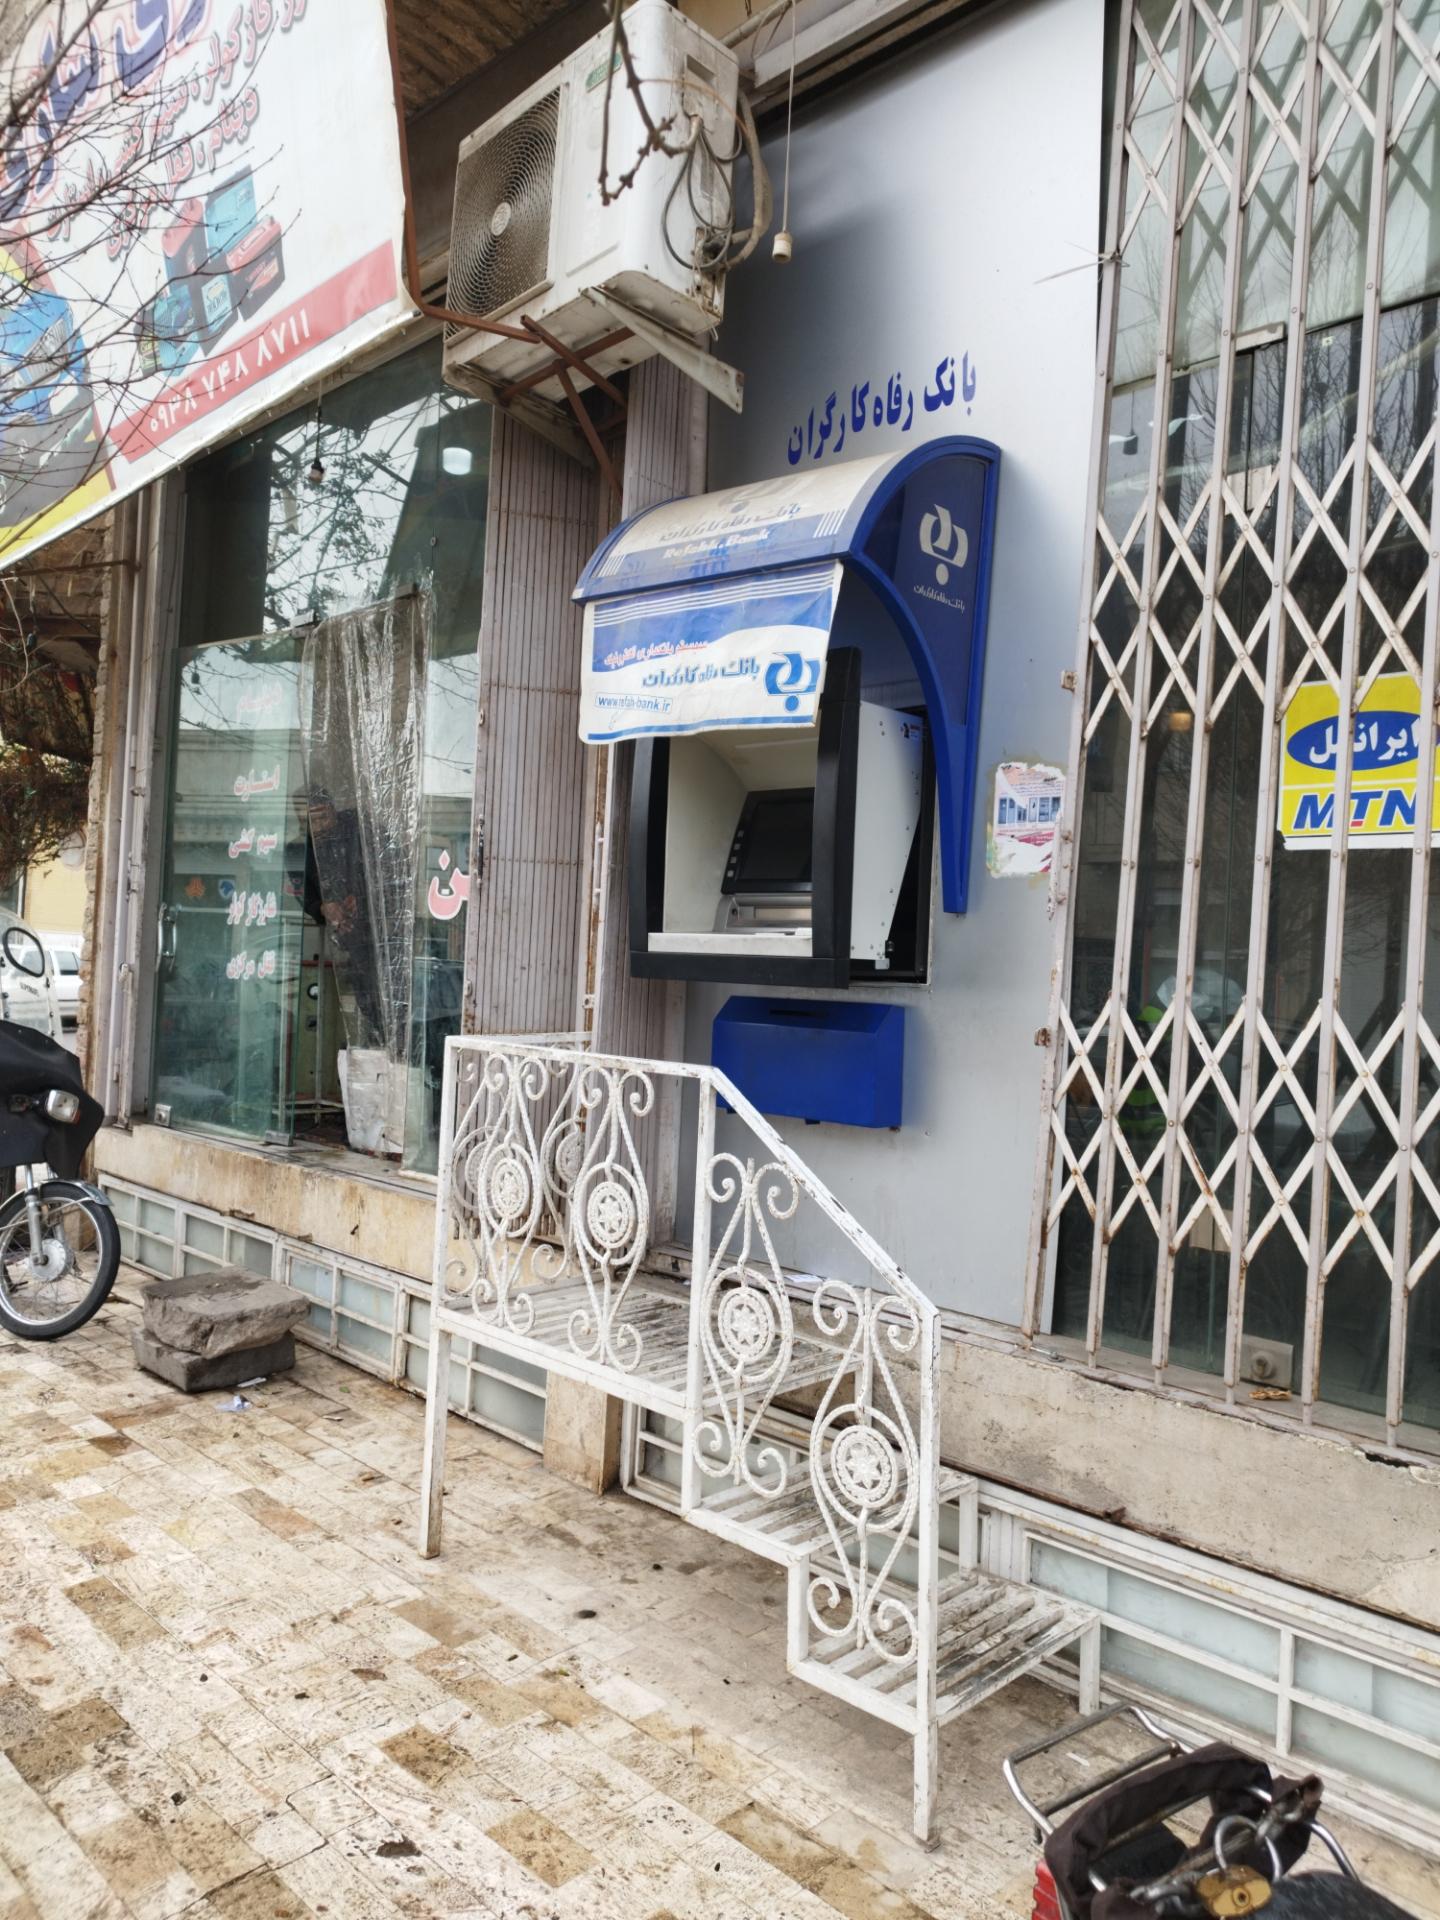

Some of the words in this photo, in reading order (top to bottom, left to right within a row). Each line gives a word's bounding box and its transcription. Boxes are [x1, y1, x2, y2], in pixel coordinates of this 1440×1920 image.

[256, 308, 310, 367] ۸۷۱۱
[924, 350, 976, 417] بانک
[872, 371, 914, 432] رفاه
[787, 380, 870, 466] کارگران
[721, 513, 752, 530] رفاه
[754, 502, 801, 523] بانک
[660, 519, 720, 542] کارگران
[676, 639, 709, 656] سیستم
[642, 664, 700, 687] کارگران
[721, 655, 761, 681] بانک
[1308, 716, 1421, 765] ایرانل
[233, 764, 281, 802] استارت
[1292, 788, 1419, 831] MTN
[228, 828, 256, 859] کشی
[256, 832, 278, 855] سیم
[226, 950, 256, 981] مرکزی
[258, 950, 276, 979] قفل
